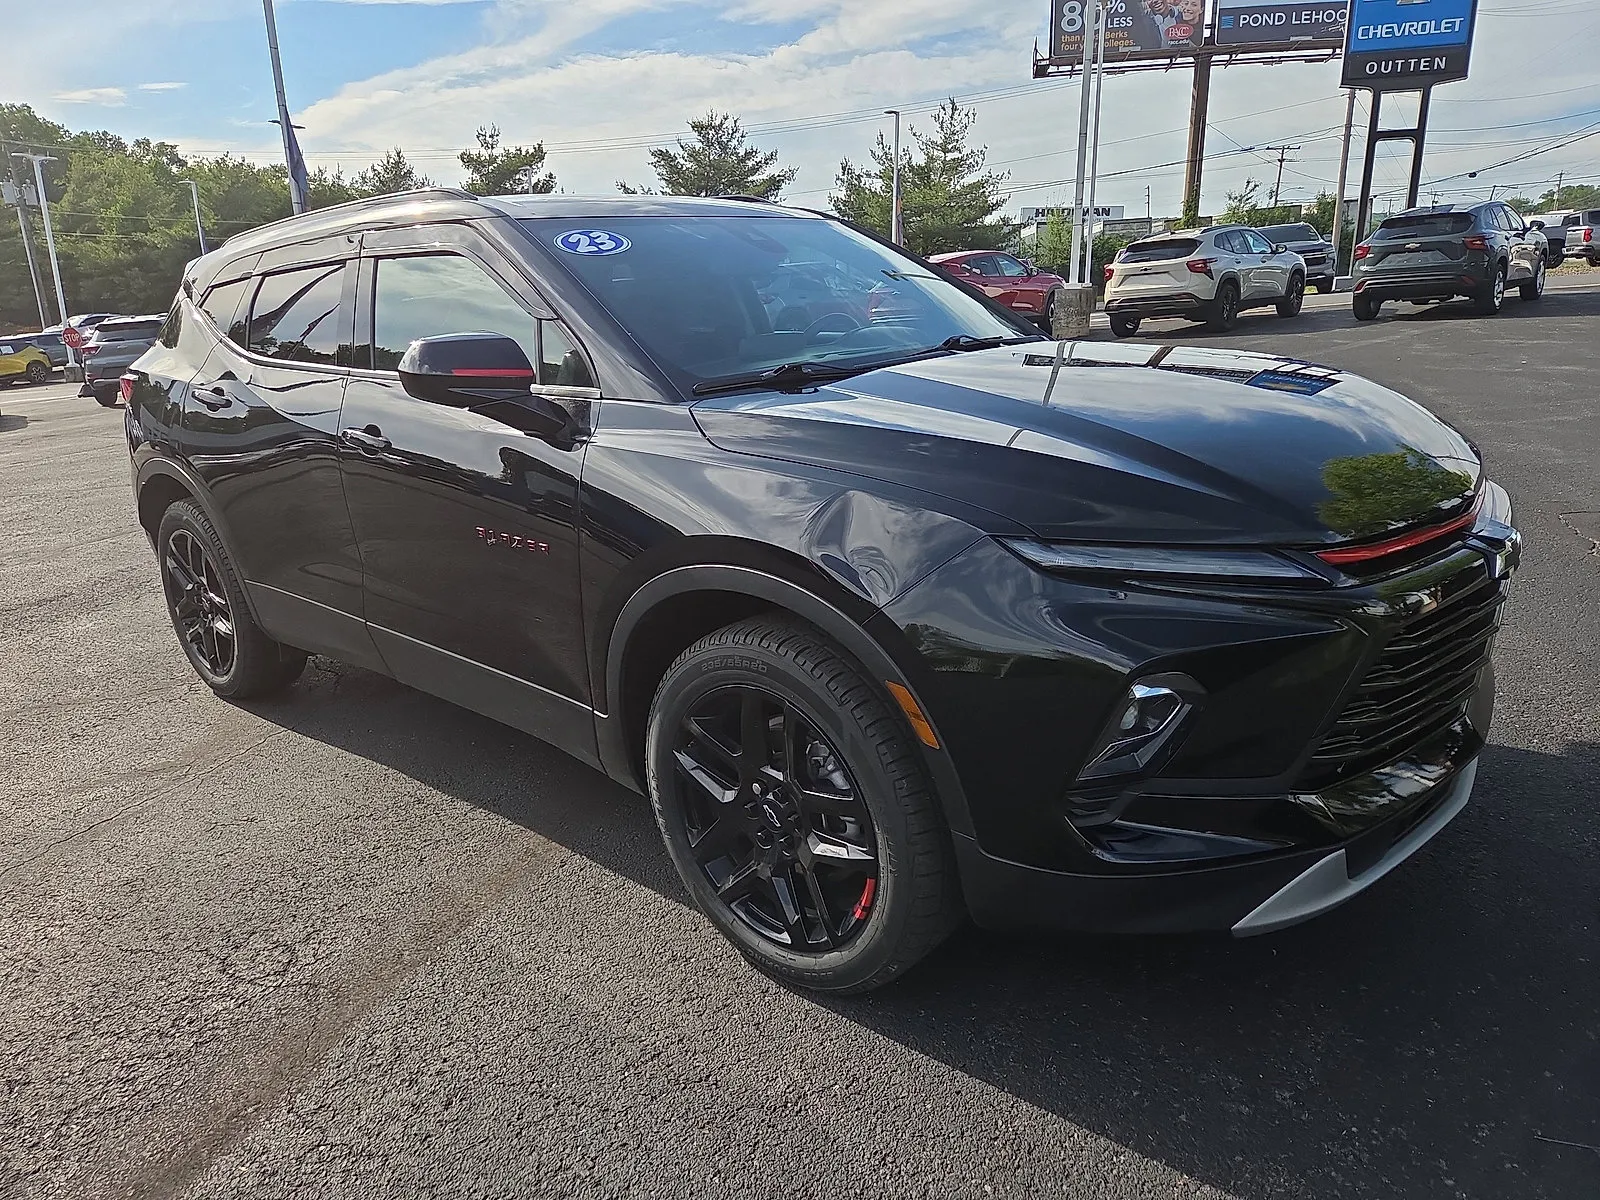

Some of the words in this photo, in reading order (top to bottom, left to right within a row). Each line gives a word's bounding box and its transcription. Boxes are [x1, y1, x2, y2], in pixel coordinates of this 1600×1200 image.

[1107, 17, 1133, 28] LESS
[1239, 12, 1286, 28] POND
[1357, 17, 1465, 40] CHEVROLET
[1061, 34, 1081, 43] than
[1105, 30, 1129, 40] Berks
[1061, 43, 1079, 51] four
[1103, 38, 1136, 49] olleges.
[1365, 56, 1447, 75] OUTTEN
[568, 231, 616, 252] 23
[63, 333, 79, 342] STOP
